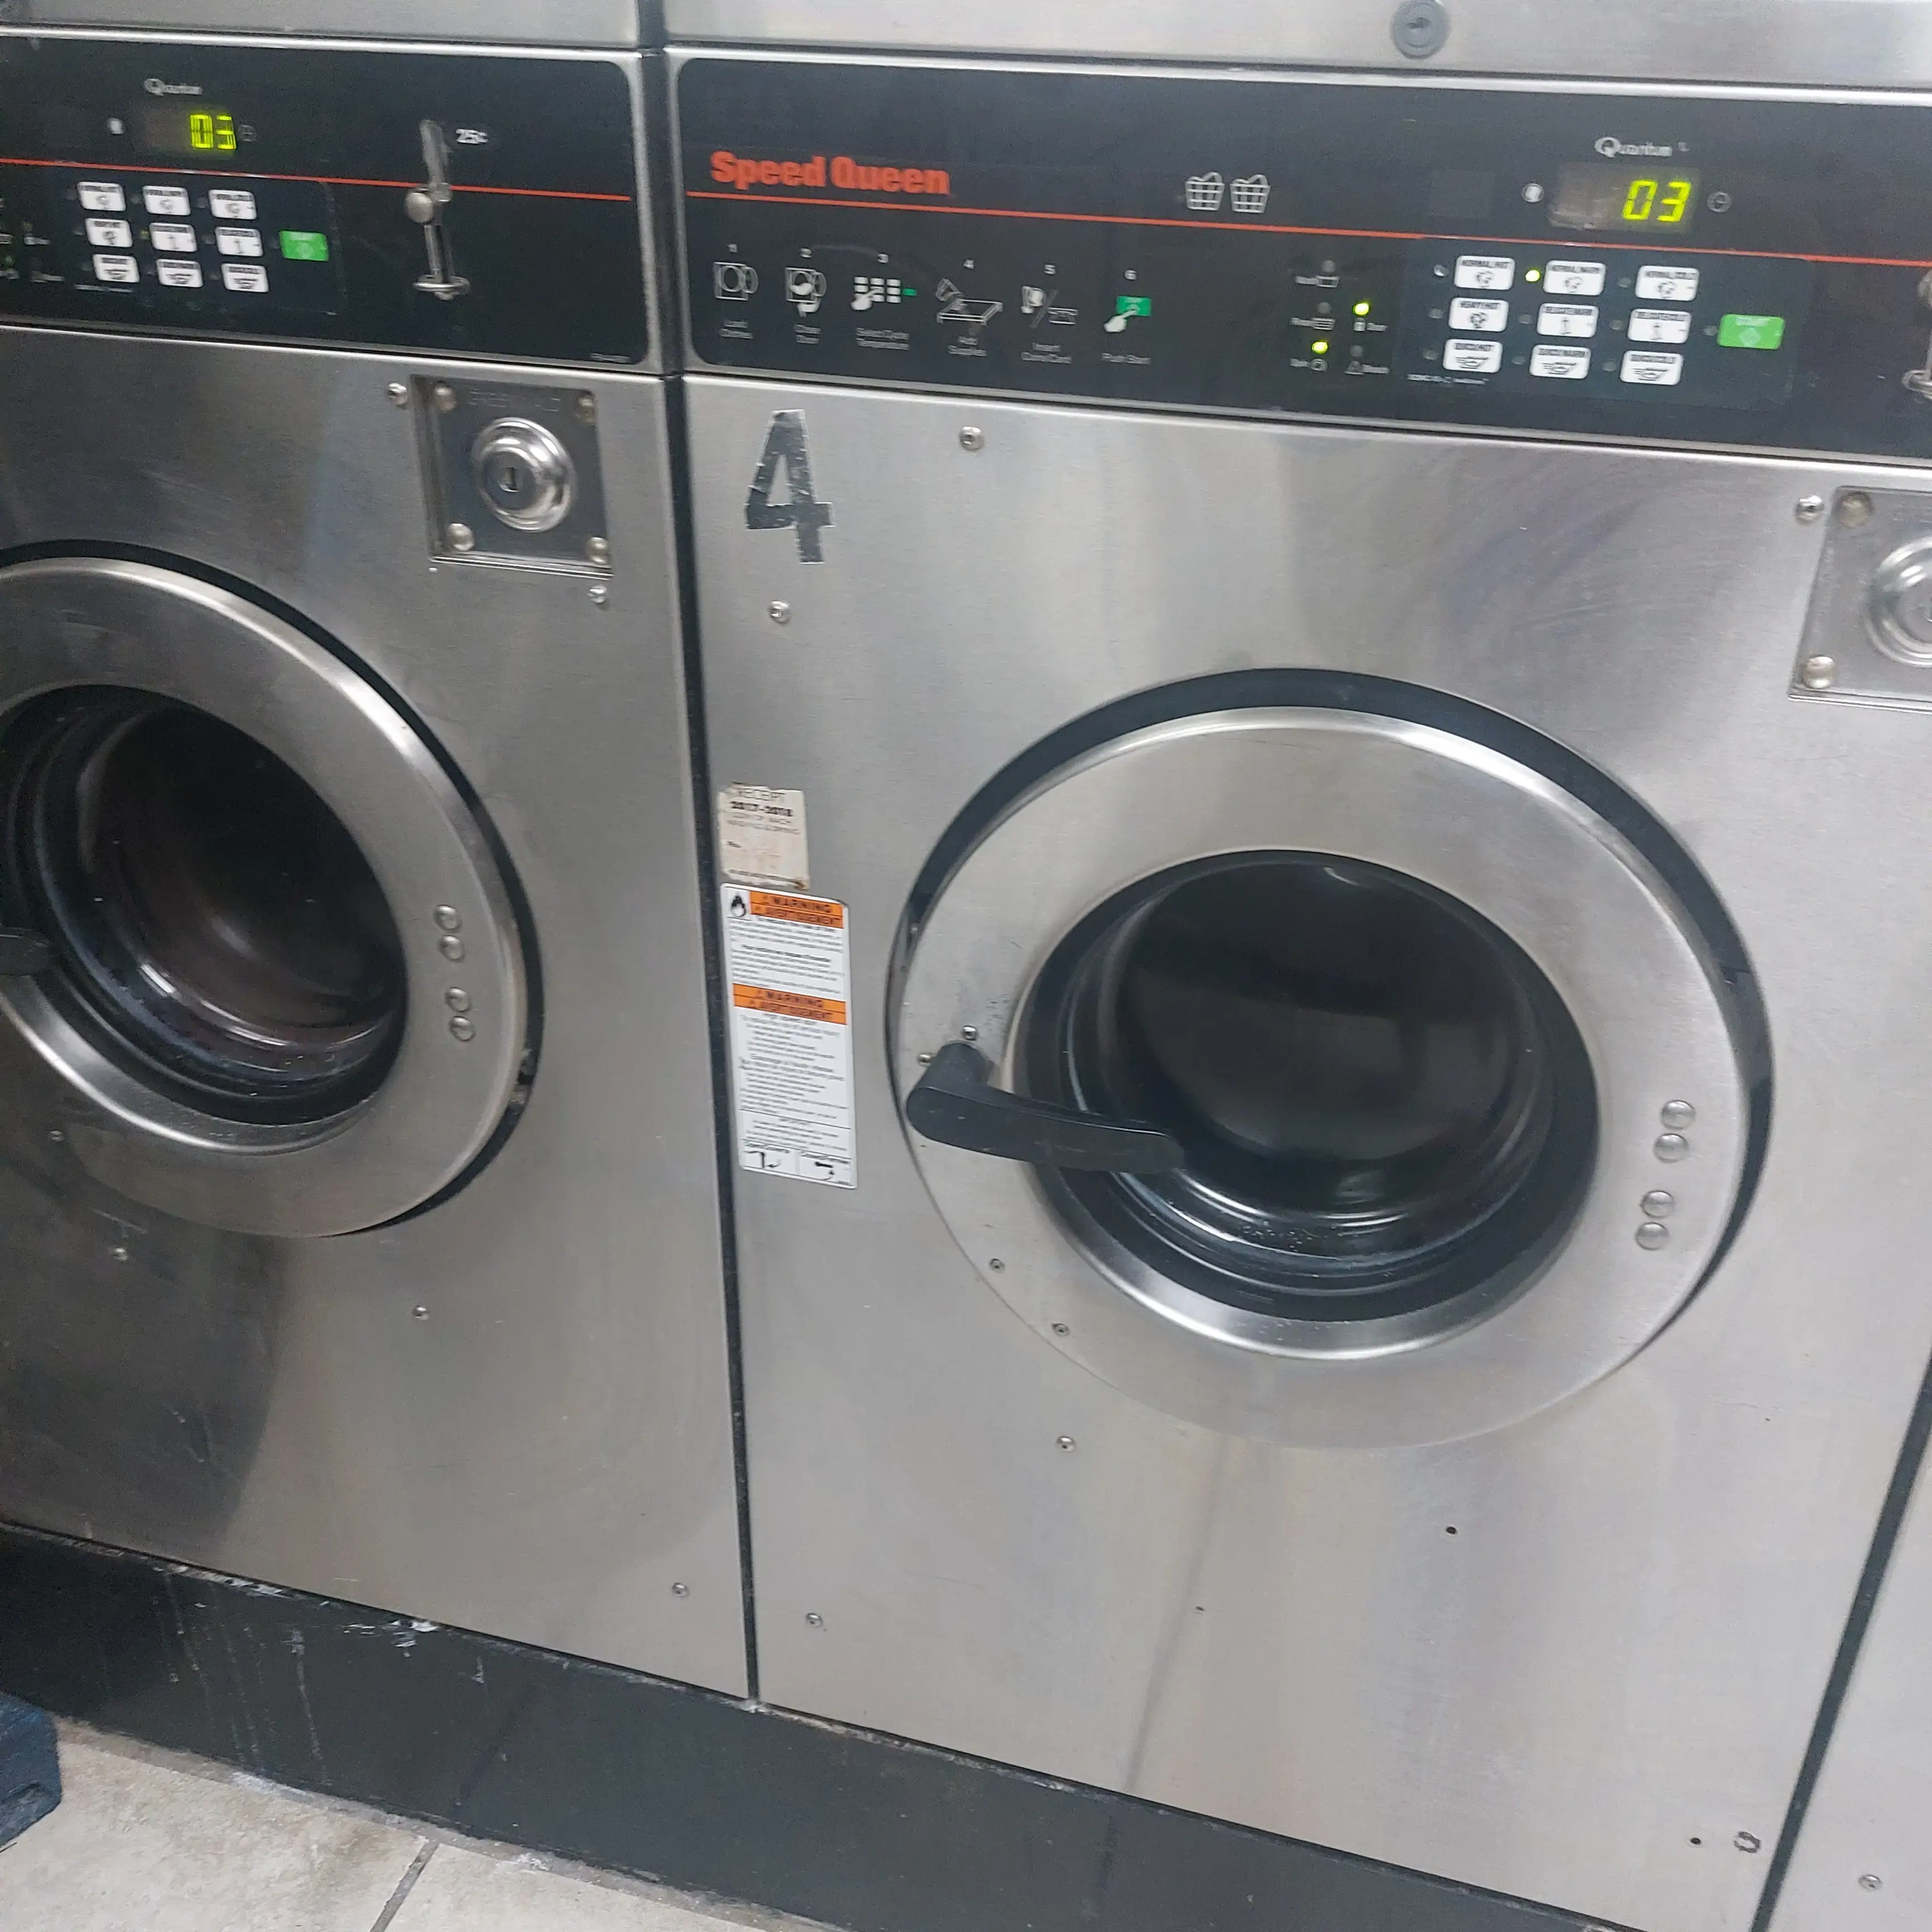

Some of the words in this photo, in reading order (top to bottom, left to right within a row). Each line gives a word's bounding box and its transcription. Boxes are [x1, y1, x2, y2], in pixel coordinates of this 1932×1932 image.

[191, 114, 236, 149] 03
[711, 151, 826, 190] Speed
[831, 156, 950, 195] Queen
[1622, 179, 1692, 222] 03
[878, 253, 888, 263] 3
[1044, 264, 1055, 275] 5
[1124, 269, 1137, 280] 6
[745, 409, 835, 565] 4
